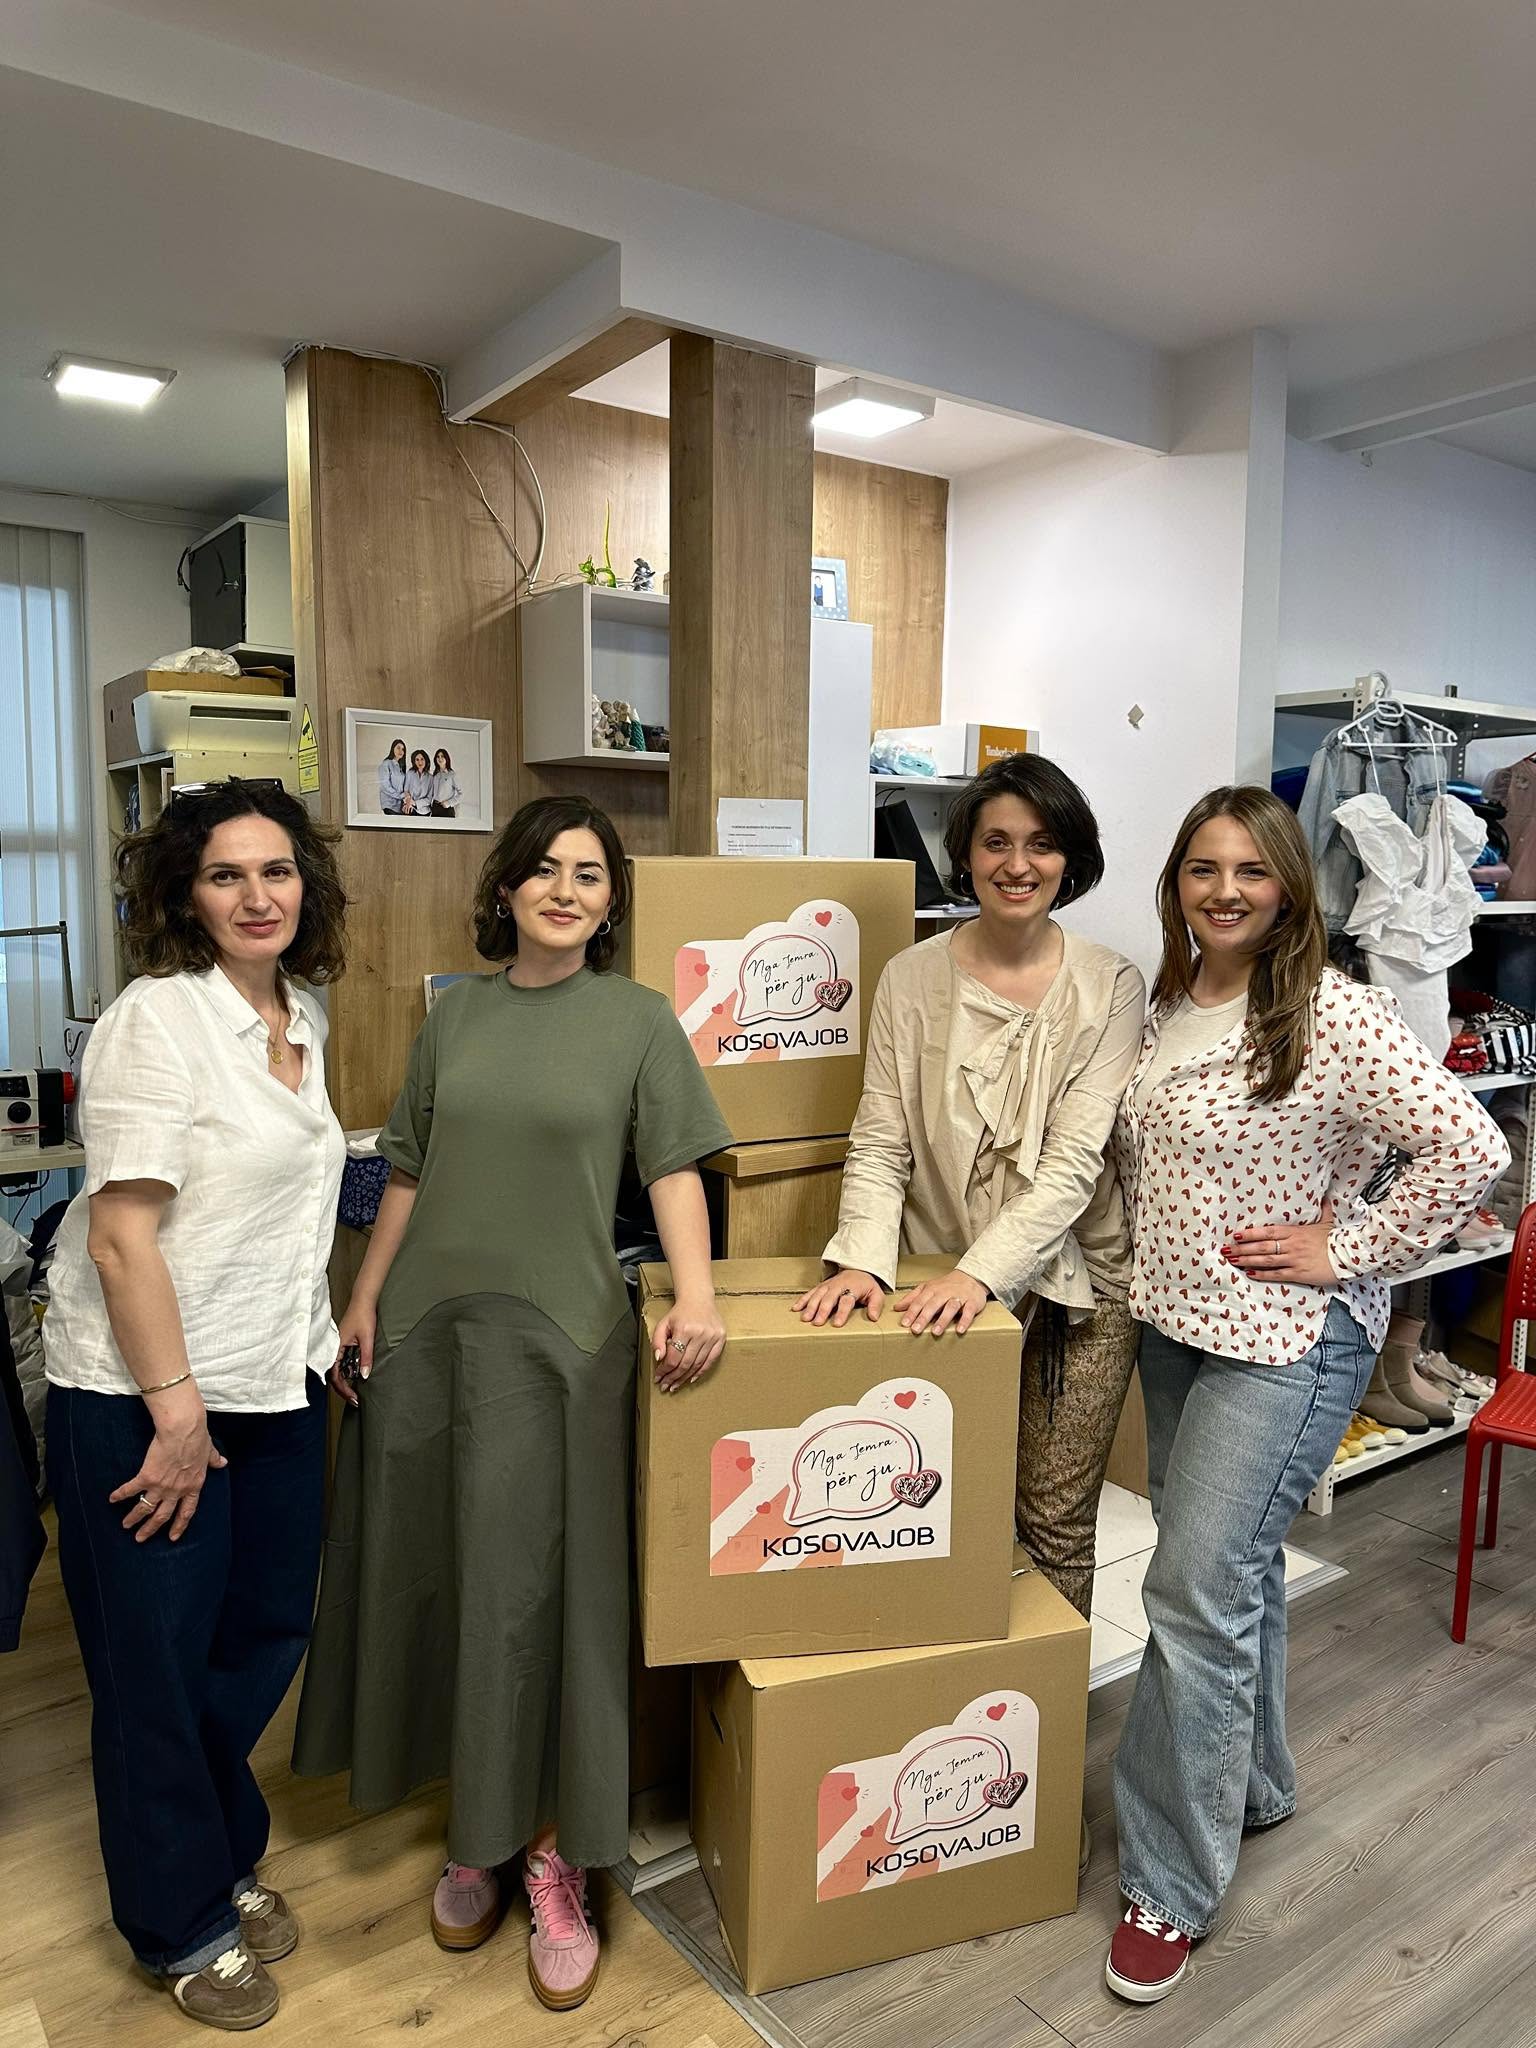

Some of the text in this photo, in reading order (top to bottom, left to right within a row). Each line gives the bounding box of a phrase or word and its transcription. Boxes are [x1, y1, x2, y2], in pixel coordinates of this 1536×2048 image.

[746, 959, 779, 982] Nga
[765, 979, 789, 1009] për
[718, 1028, 849, 1053] KOSOVAJOB
[803, 1450, 845, 1476] Nga
[826, 1472, 857, 1508] për
[763, 1526, 935, 1558] KOSOVAJOB
[903, 1769, 942, 1793] Nga
[924, 1787, 952, 1823] për
[866, 1824, 1021, 1878] KOSOVAJOB
